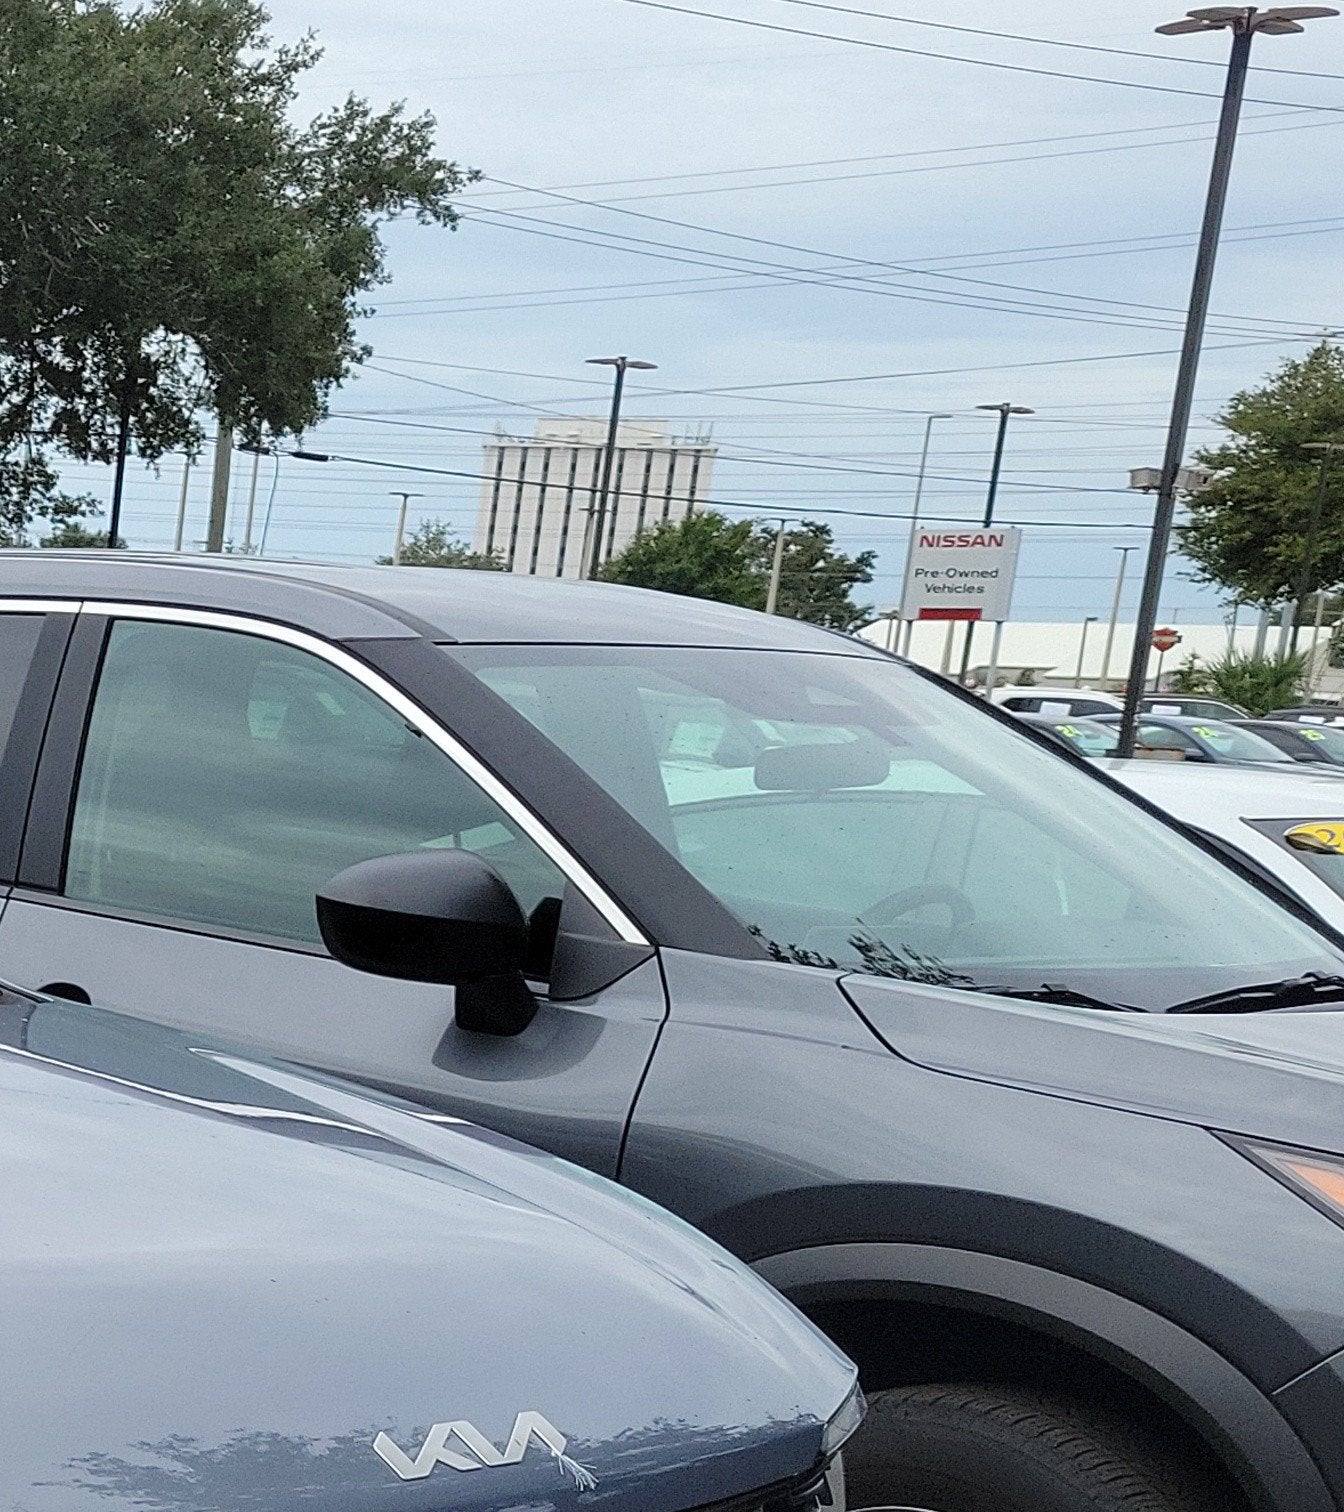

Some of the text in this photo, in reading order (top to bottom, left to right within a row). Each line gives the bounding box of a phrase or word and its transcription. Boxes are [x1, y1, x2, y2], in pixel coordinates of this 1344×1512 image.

[919, 534, 1005, 548] NISSAN
[914, 567, 999, 579] Pre-Owned
[924, 583, 985, 594] Vehicles
